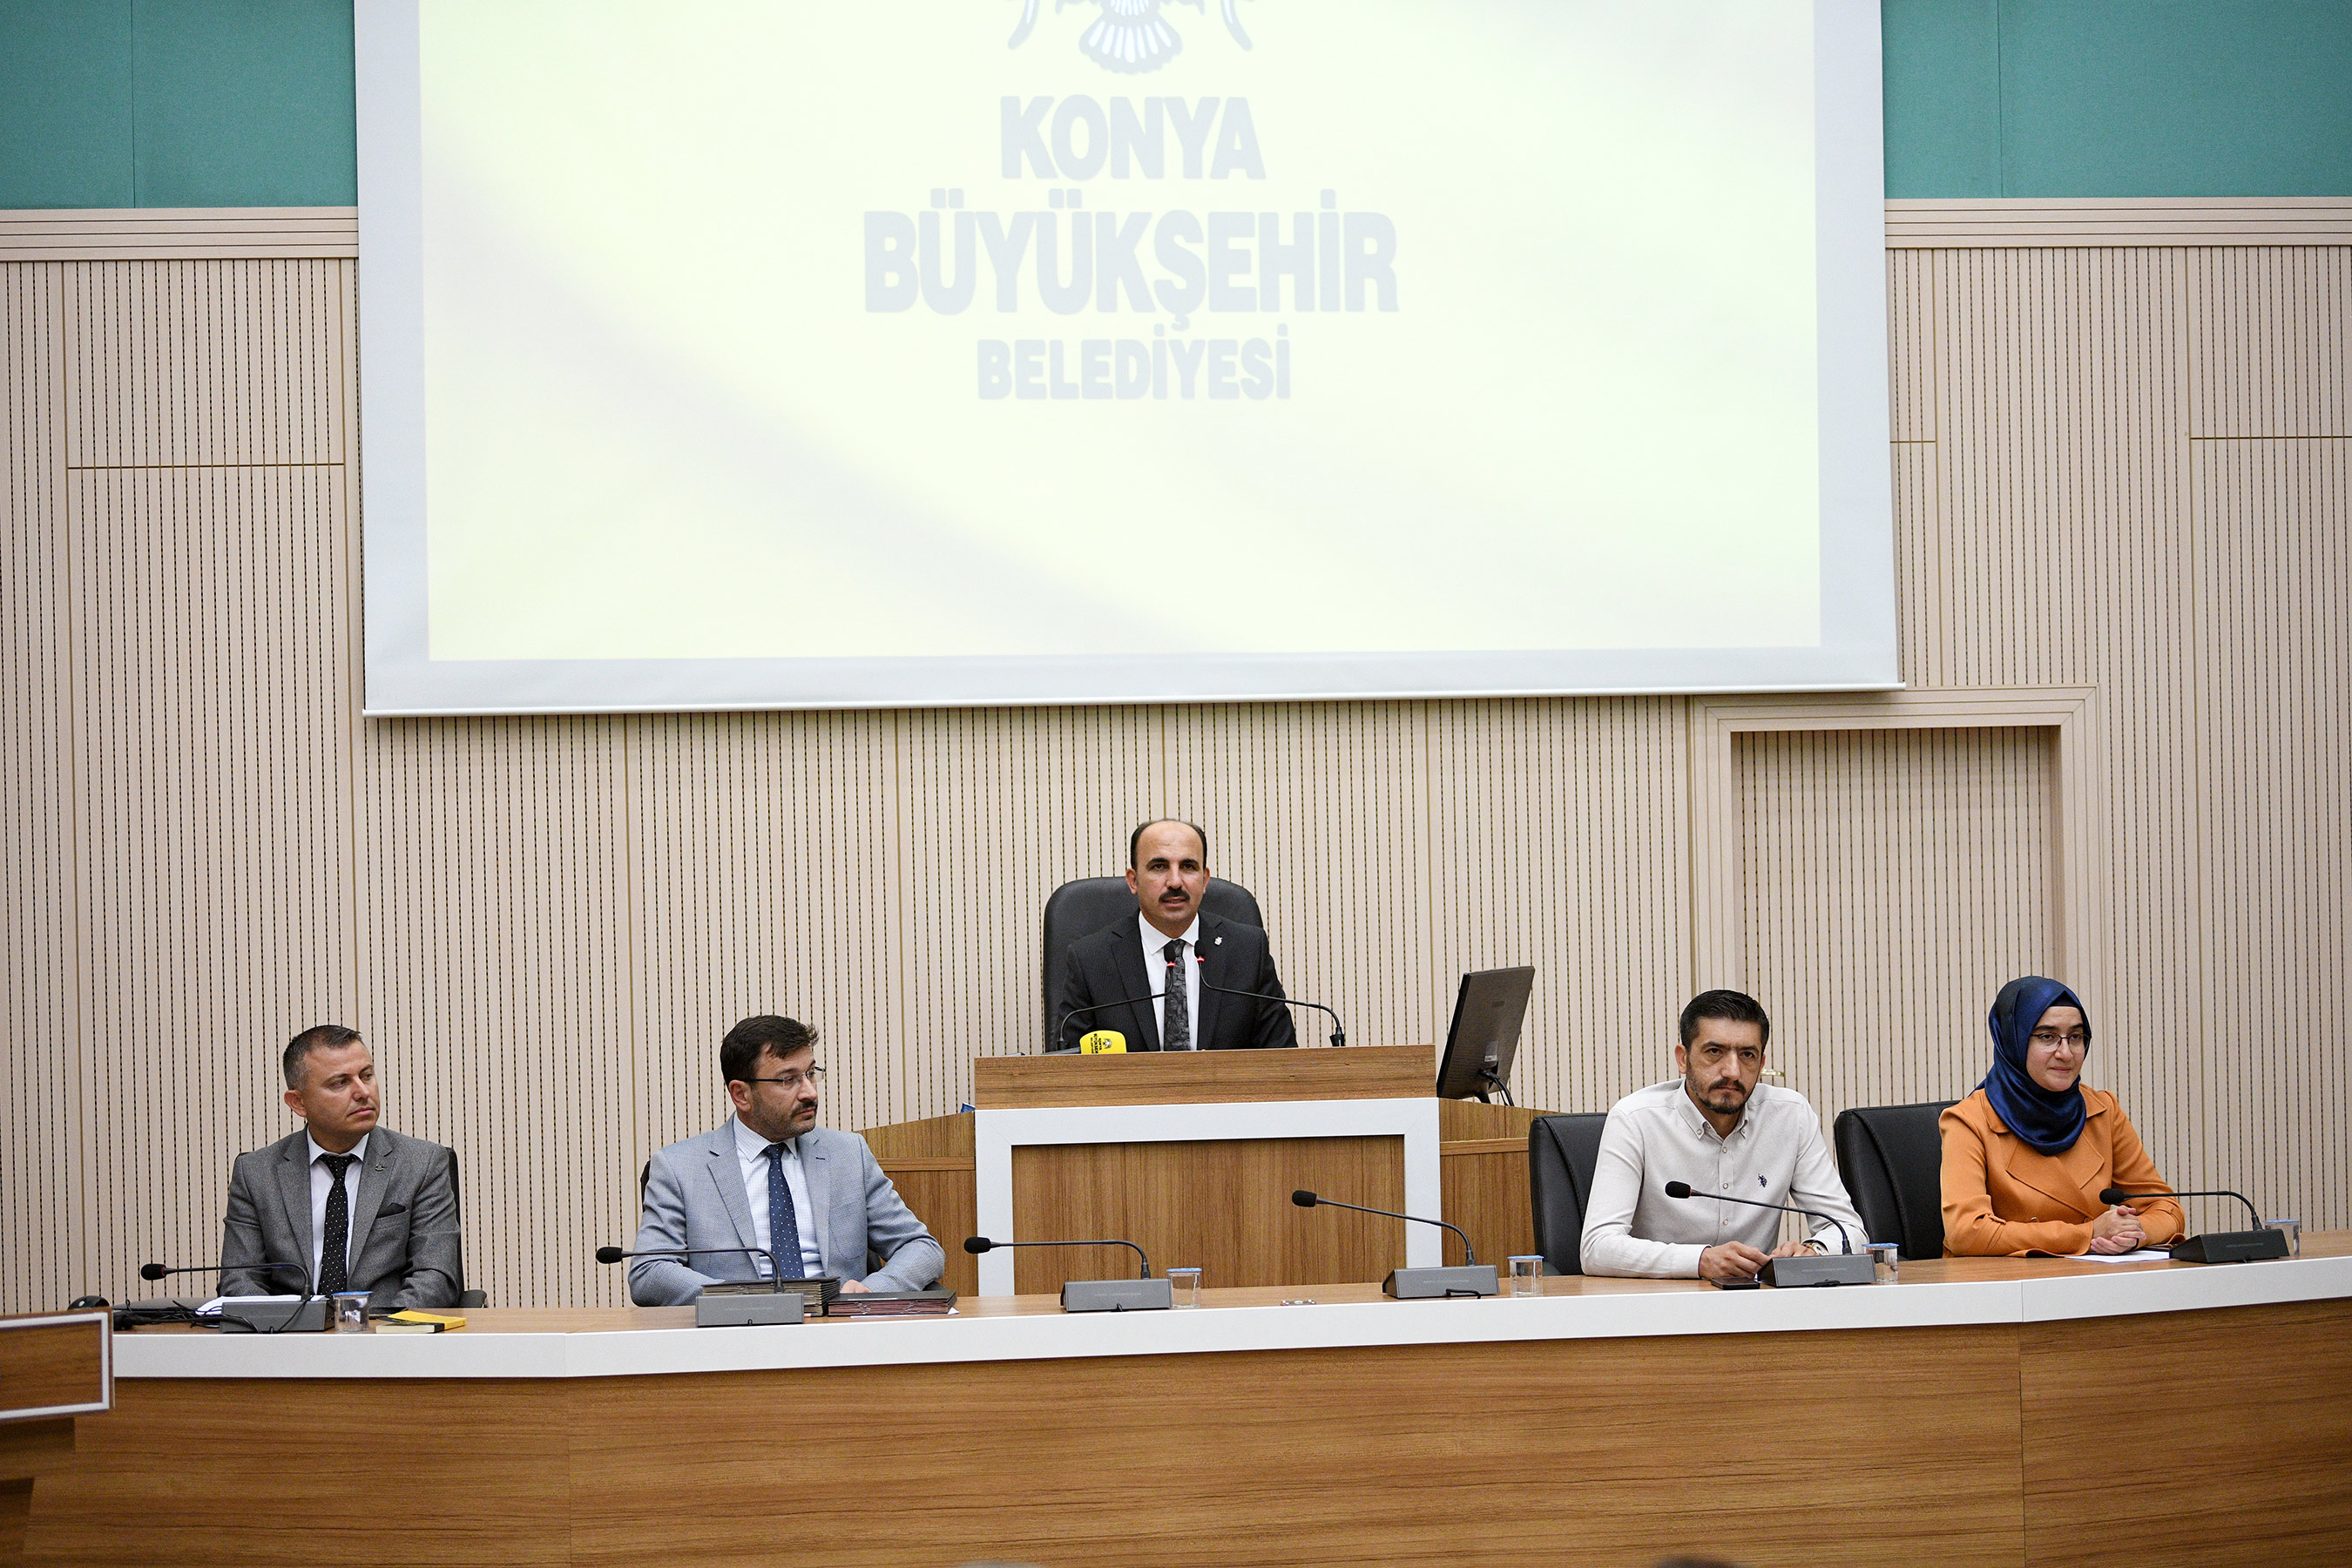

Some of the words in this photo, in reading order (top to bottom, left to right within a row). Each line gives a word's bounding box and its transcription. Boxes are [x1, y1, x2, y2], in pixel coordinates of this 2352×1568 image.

[1000, 94, 1267, 181] KONYA
[863, 187, 1399, 331] BÜYÜKŞEHİR
[977, 323, 1291, 400] BELEDİYESİ
